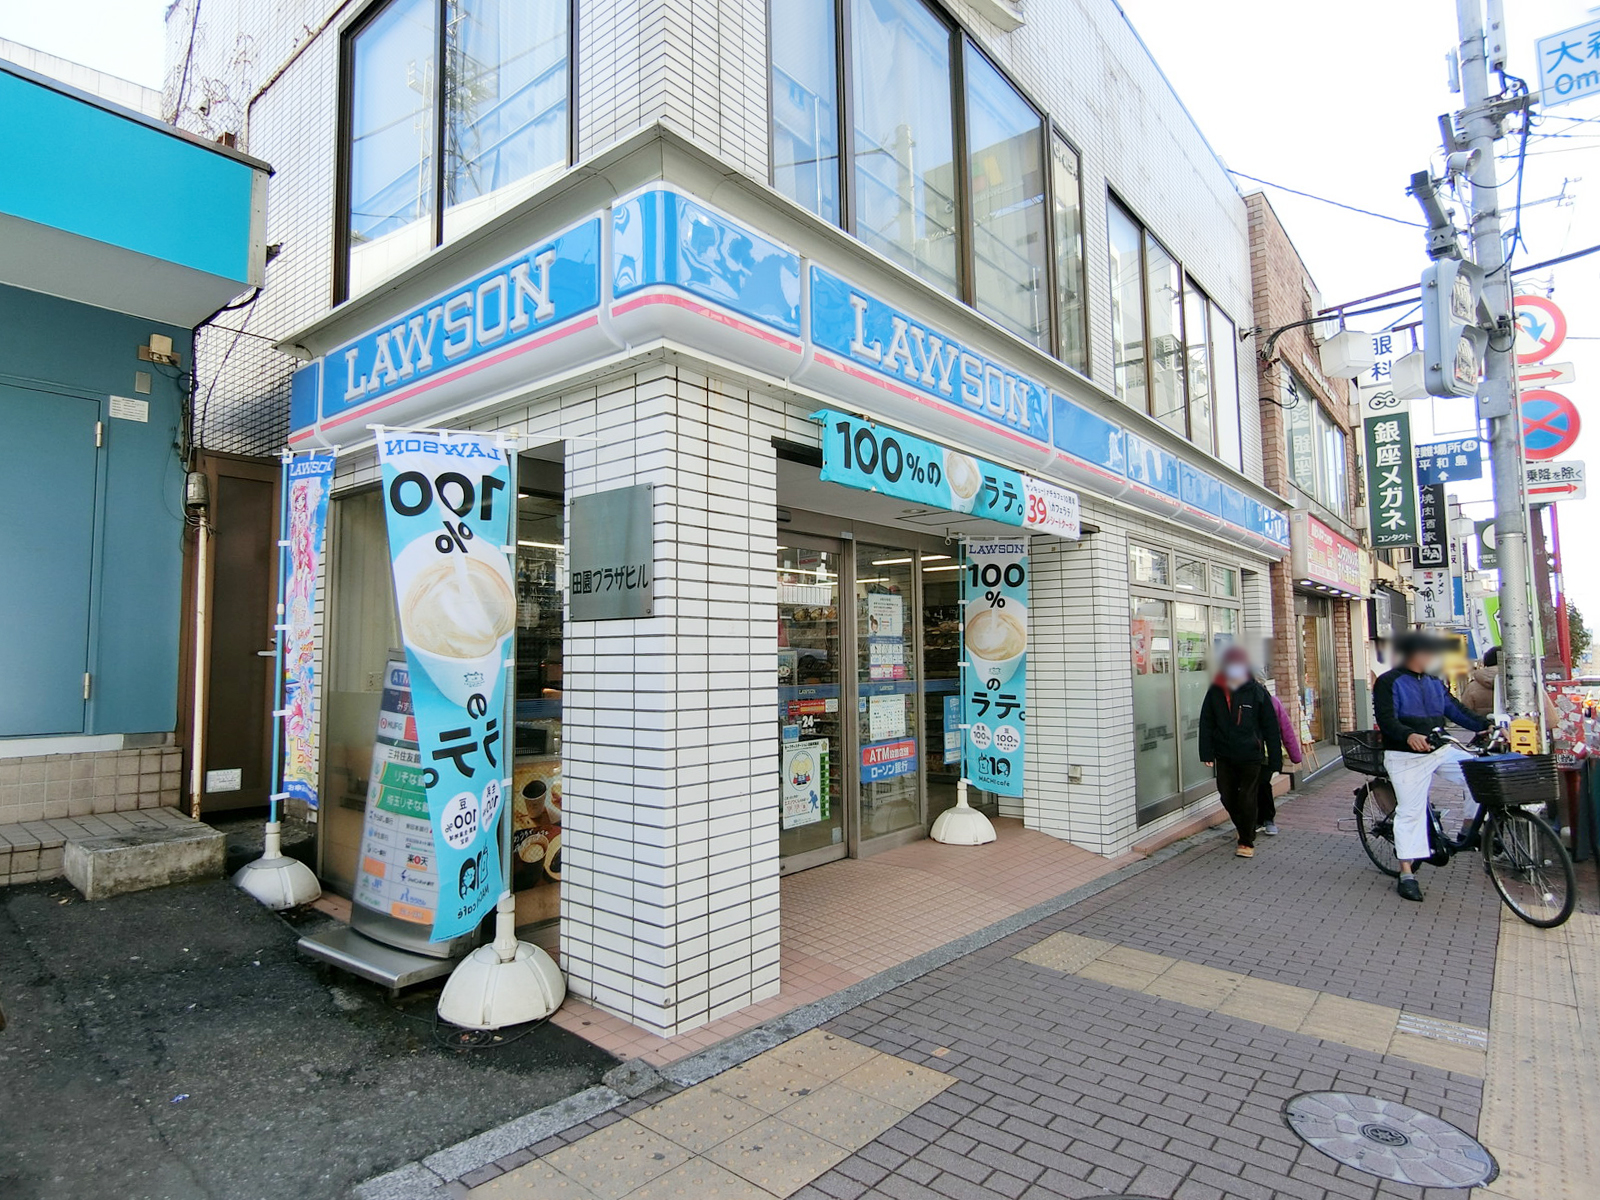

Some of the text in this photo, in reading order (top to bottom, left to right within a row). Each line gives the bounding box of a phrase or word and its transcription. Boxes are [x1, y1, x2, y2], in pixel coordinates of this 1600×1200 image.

[344, 248, 555, 402] LAWSON
[850, 293, 1031, 429] LAWSON
[1371, 335, 1393, 381] 眼科
[836, 421, 1023, 516] 100%の ラテ。
[1418, 454, 1468, 471] 平和島
[1373, 420, 1406, 531] 銀座メガネ
[1526, 466, 1583, 482] 乗降を除く
[1027, 494, 1047, 524] 39
[1377, 533, 1412, 543] コンタクト
[968, 544, 1025, 555] LAWSON
[572, 563, 649, 595] 田園プラザビル
[967, 563, 1025, 588] 100
[985, 591, 1006, 608] %
[986, 678, 1001, 691] の
[802, 715, 815, 728] 24
[871, 760, 909, 778] ローソン銀行
